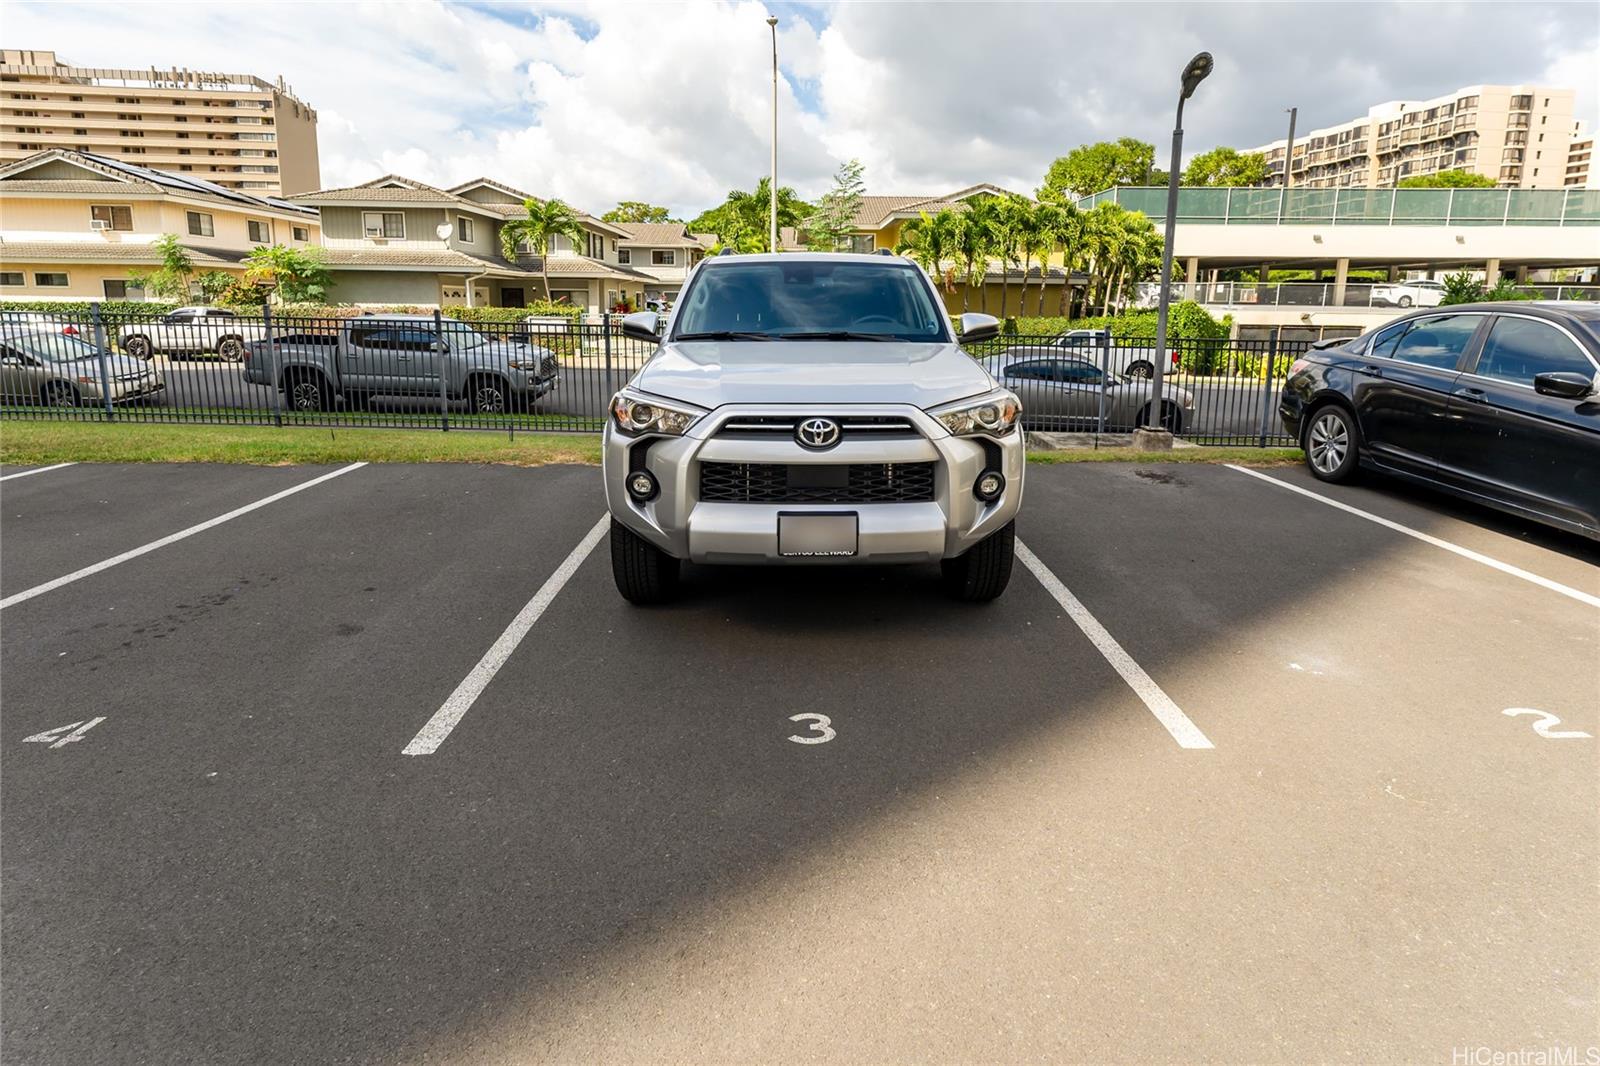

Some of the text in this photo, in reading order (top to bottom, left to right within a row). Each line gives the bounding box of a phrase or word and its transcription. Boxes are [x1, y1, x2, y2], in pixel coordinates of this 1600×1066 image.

[22, 716, 108, 749] 4
[787, 712, 837, 744] 3
[1501, 707, 1595, 739] 2
